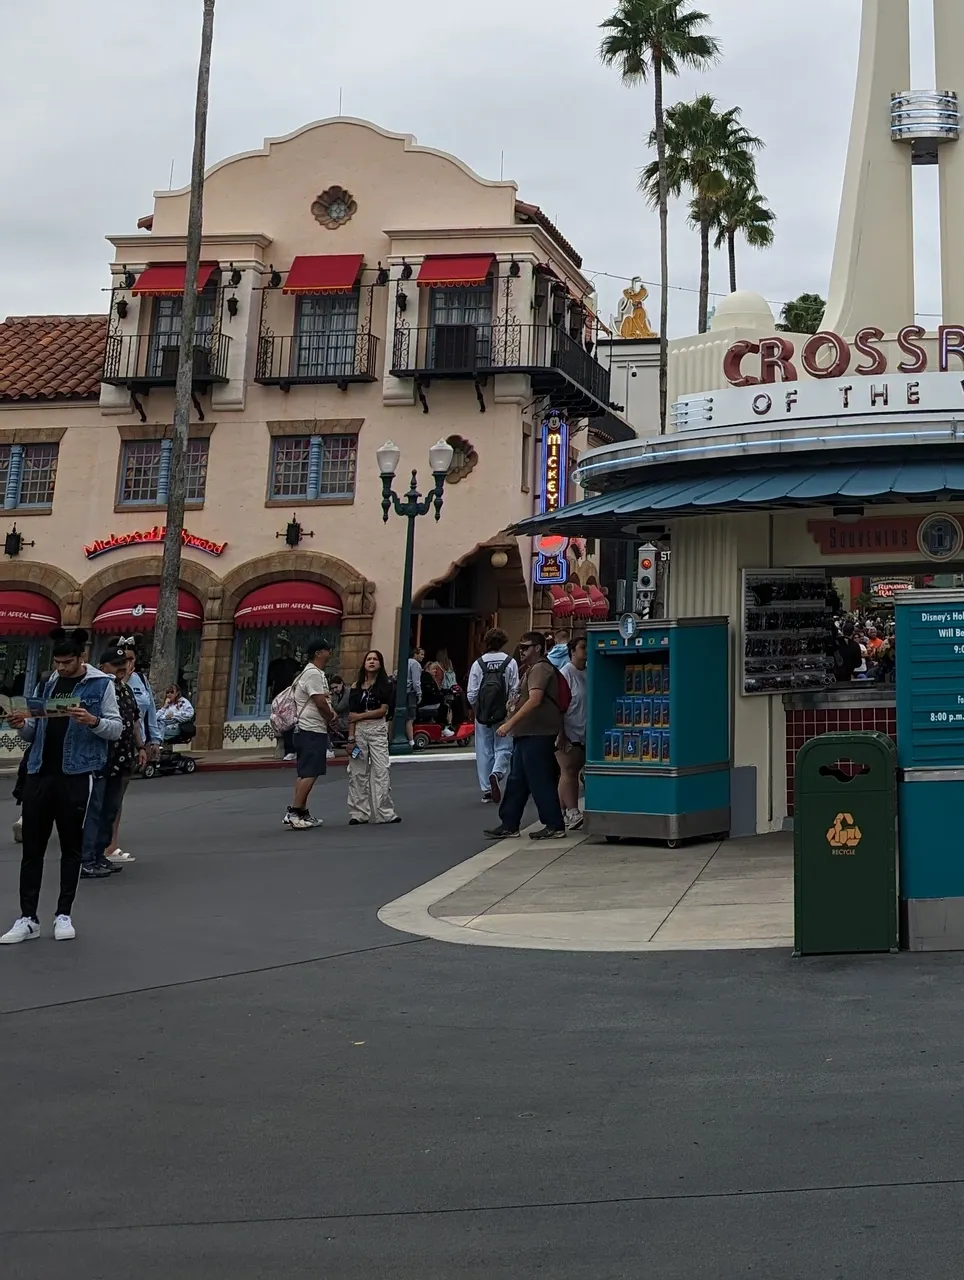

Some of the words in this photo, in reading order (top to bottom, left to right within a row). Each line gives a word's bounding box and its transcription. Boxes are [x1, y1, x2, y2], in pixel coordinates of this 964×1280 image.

[751, 389, 799, 416] OF
[838, 381, 921, 408] THE
[921, 613, 951, 623] Disney's
[938, 628, 954, 638] Will
[955, 628, 964, 637] Be
[930, 712, 947, 721] 8:00
[949, 713, 964, 722] p.m.
[832, 848, 856, 856] RECYCLE
